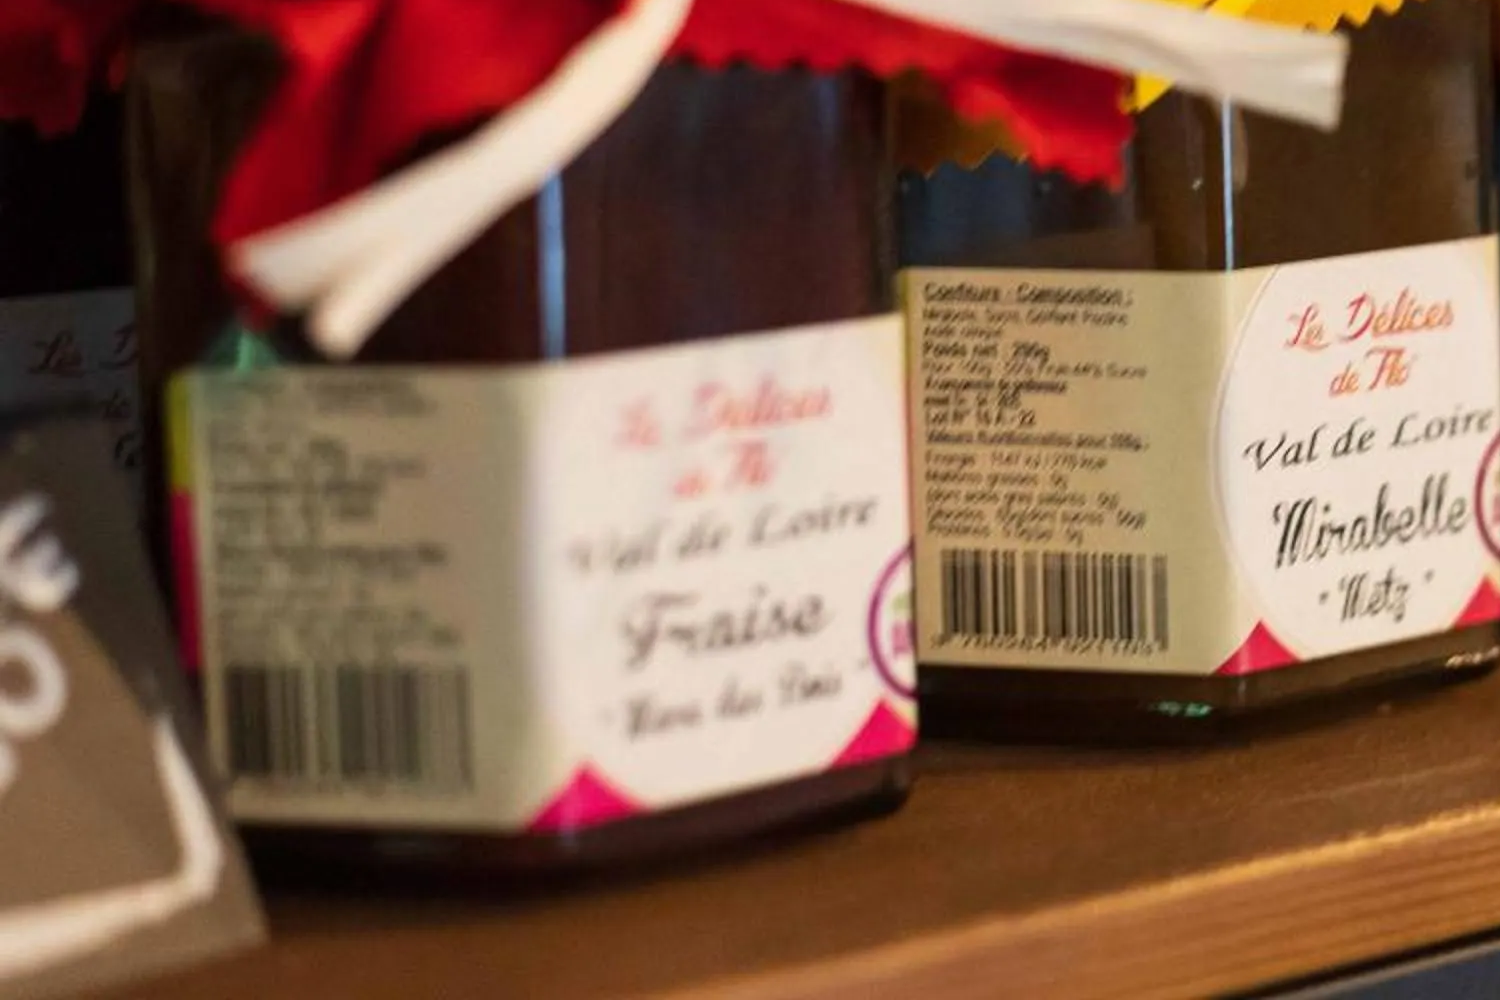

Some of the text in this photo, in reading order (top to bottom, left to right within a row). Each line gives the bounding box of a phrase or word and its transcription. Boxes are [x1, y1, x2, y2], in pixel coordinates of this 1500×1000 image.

[1329, 361, 1360, 398] de
[1242, 403, 1496, 472] Val de Loire
[749, 494, 878, 550] Loire
[1272, 471, 1469, 570] Mirabelle
[620, 583, 835, 671] Fraise
